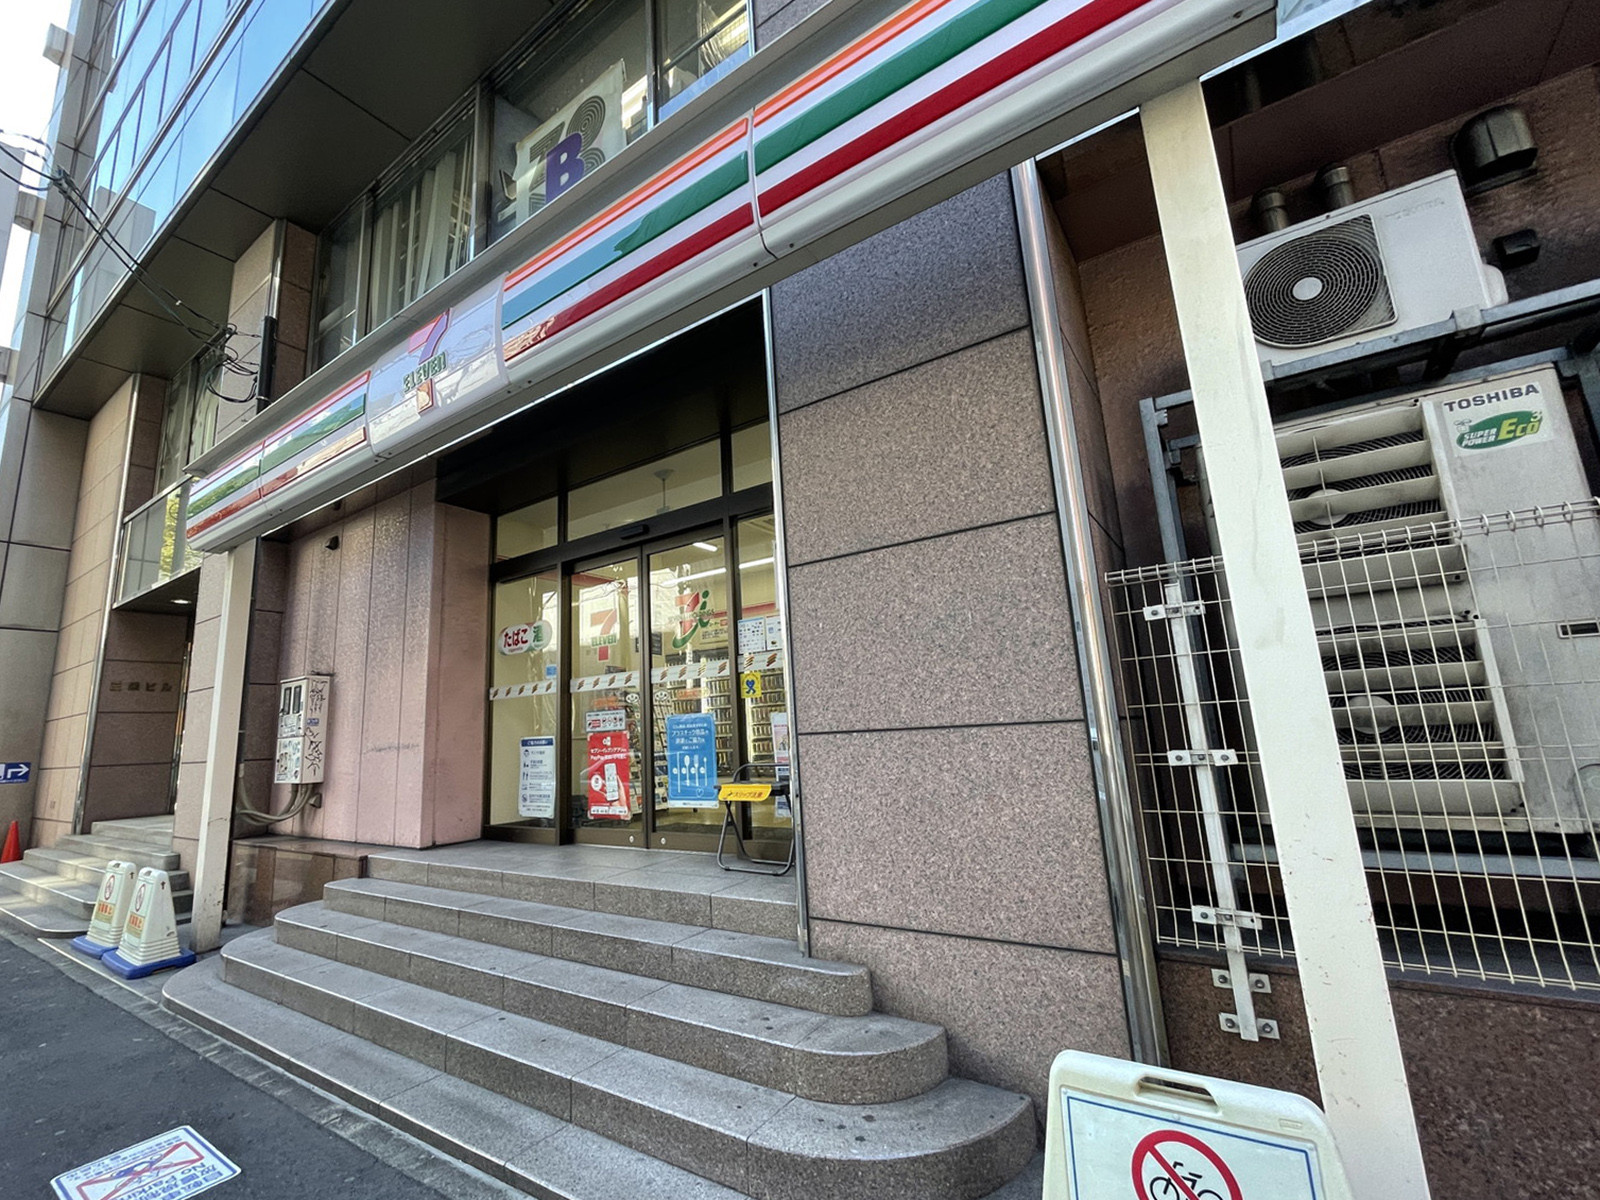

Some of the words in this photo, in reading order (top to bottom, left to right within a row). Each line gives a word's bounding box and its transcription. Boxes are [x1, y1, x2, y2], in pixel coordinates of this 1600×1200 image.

[1444, 384, 1539, 412] TOSHIBA
[1463, 428, 1497, 440] SUPER
[1461, 436, 1496, 447] POWER
[503, 629, 528, 648] たばこ
[181, 1162, 205, 1175] No
